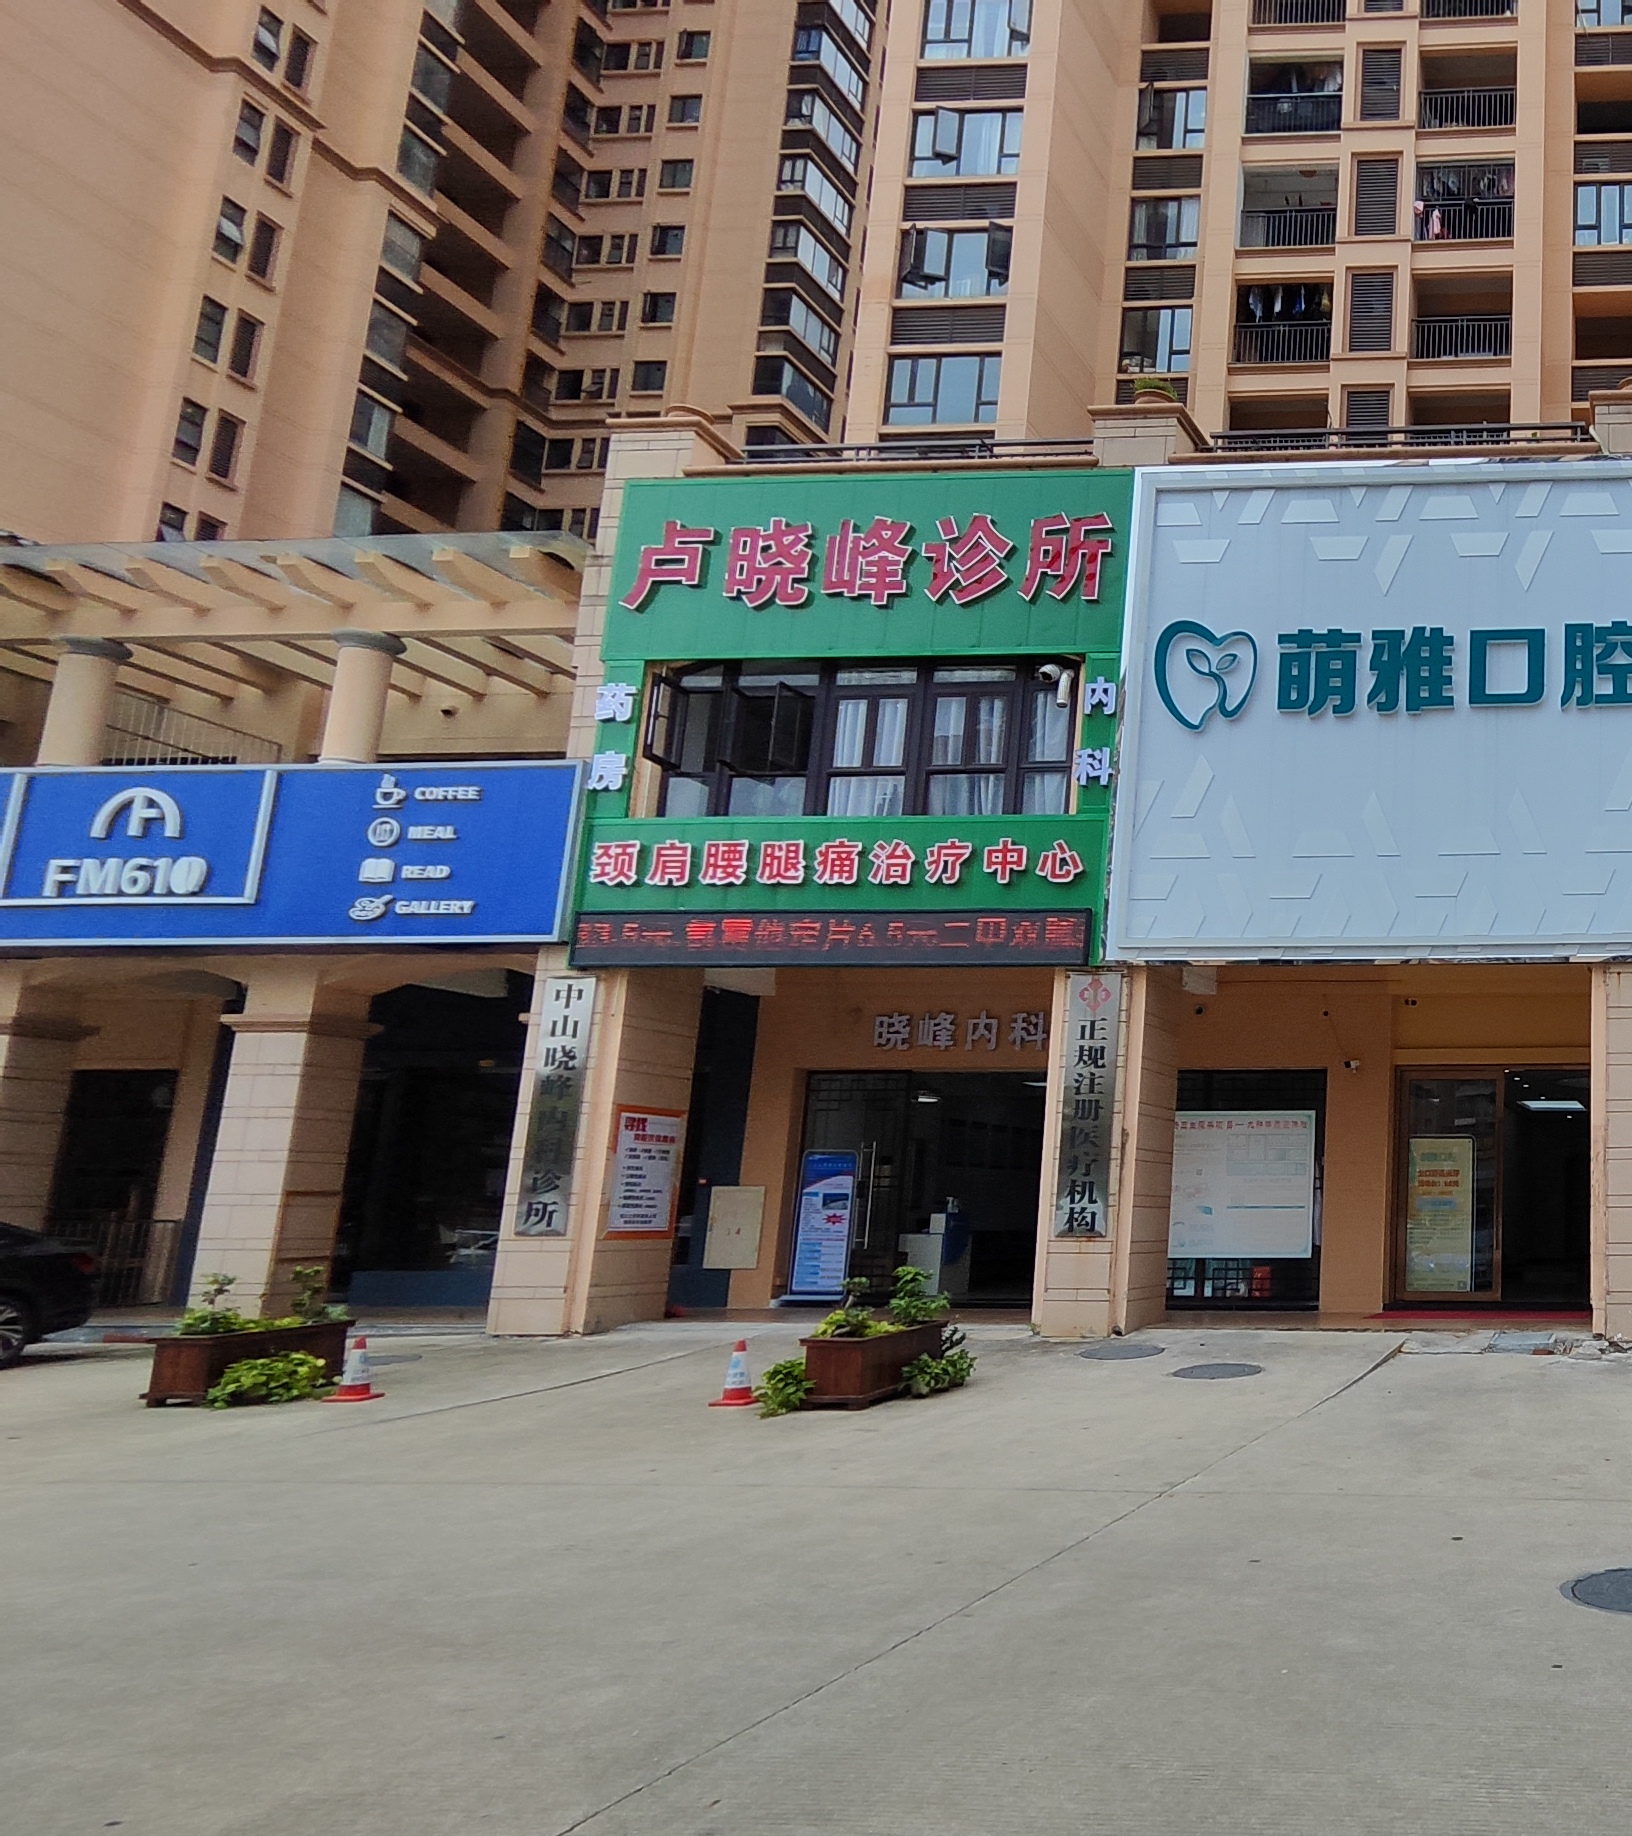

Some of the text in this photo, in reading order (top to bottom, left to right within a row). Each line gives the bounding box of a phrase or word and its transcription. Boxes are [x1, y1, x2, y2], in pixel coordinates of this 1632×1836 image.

[619, 511, 1115, 611] 卢晓峰诊所
[587, 682, 637, 793] 药房
[1073, 676, 1117, 787] 内科
[413, 785, 482, 802] COFFEE
[407, 825, 458, 841] MEAL
[41, 855, 208, 898] FM610
[401, 864, 452, 881] READ
[589, 837, 1085, 888] 颈肩腰腿痛治疗中心
[395, 898, 477, 916] GALLERY
[873, 1009, 1048, 1051] 晓峰内科
[1064, 1016, 1109, 1234] 正规注册医疗机构
